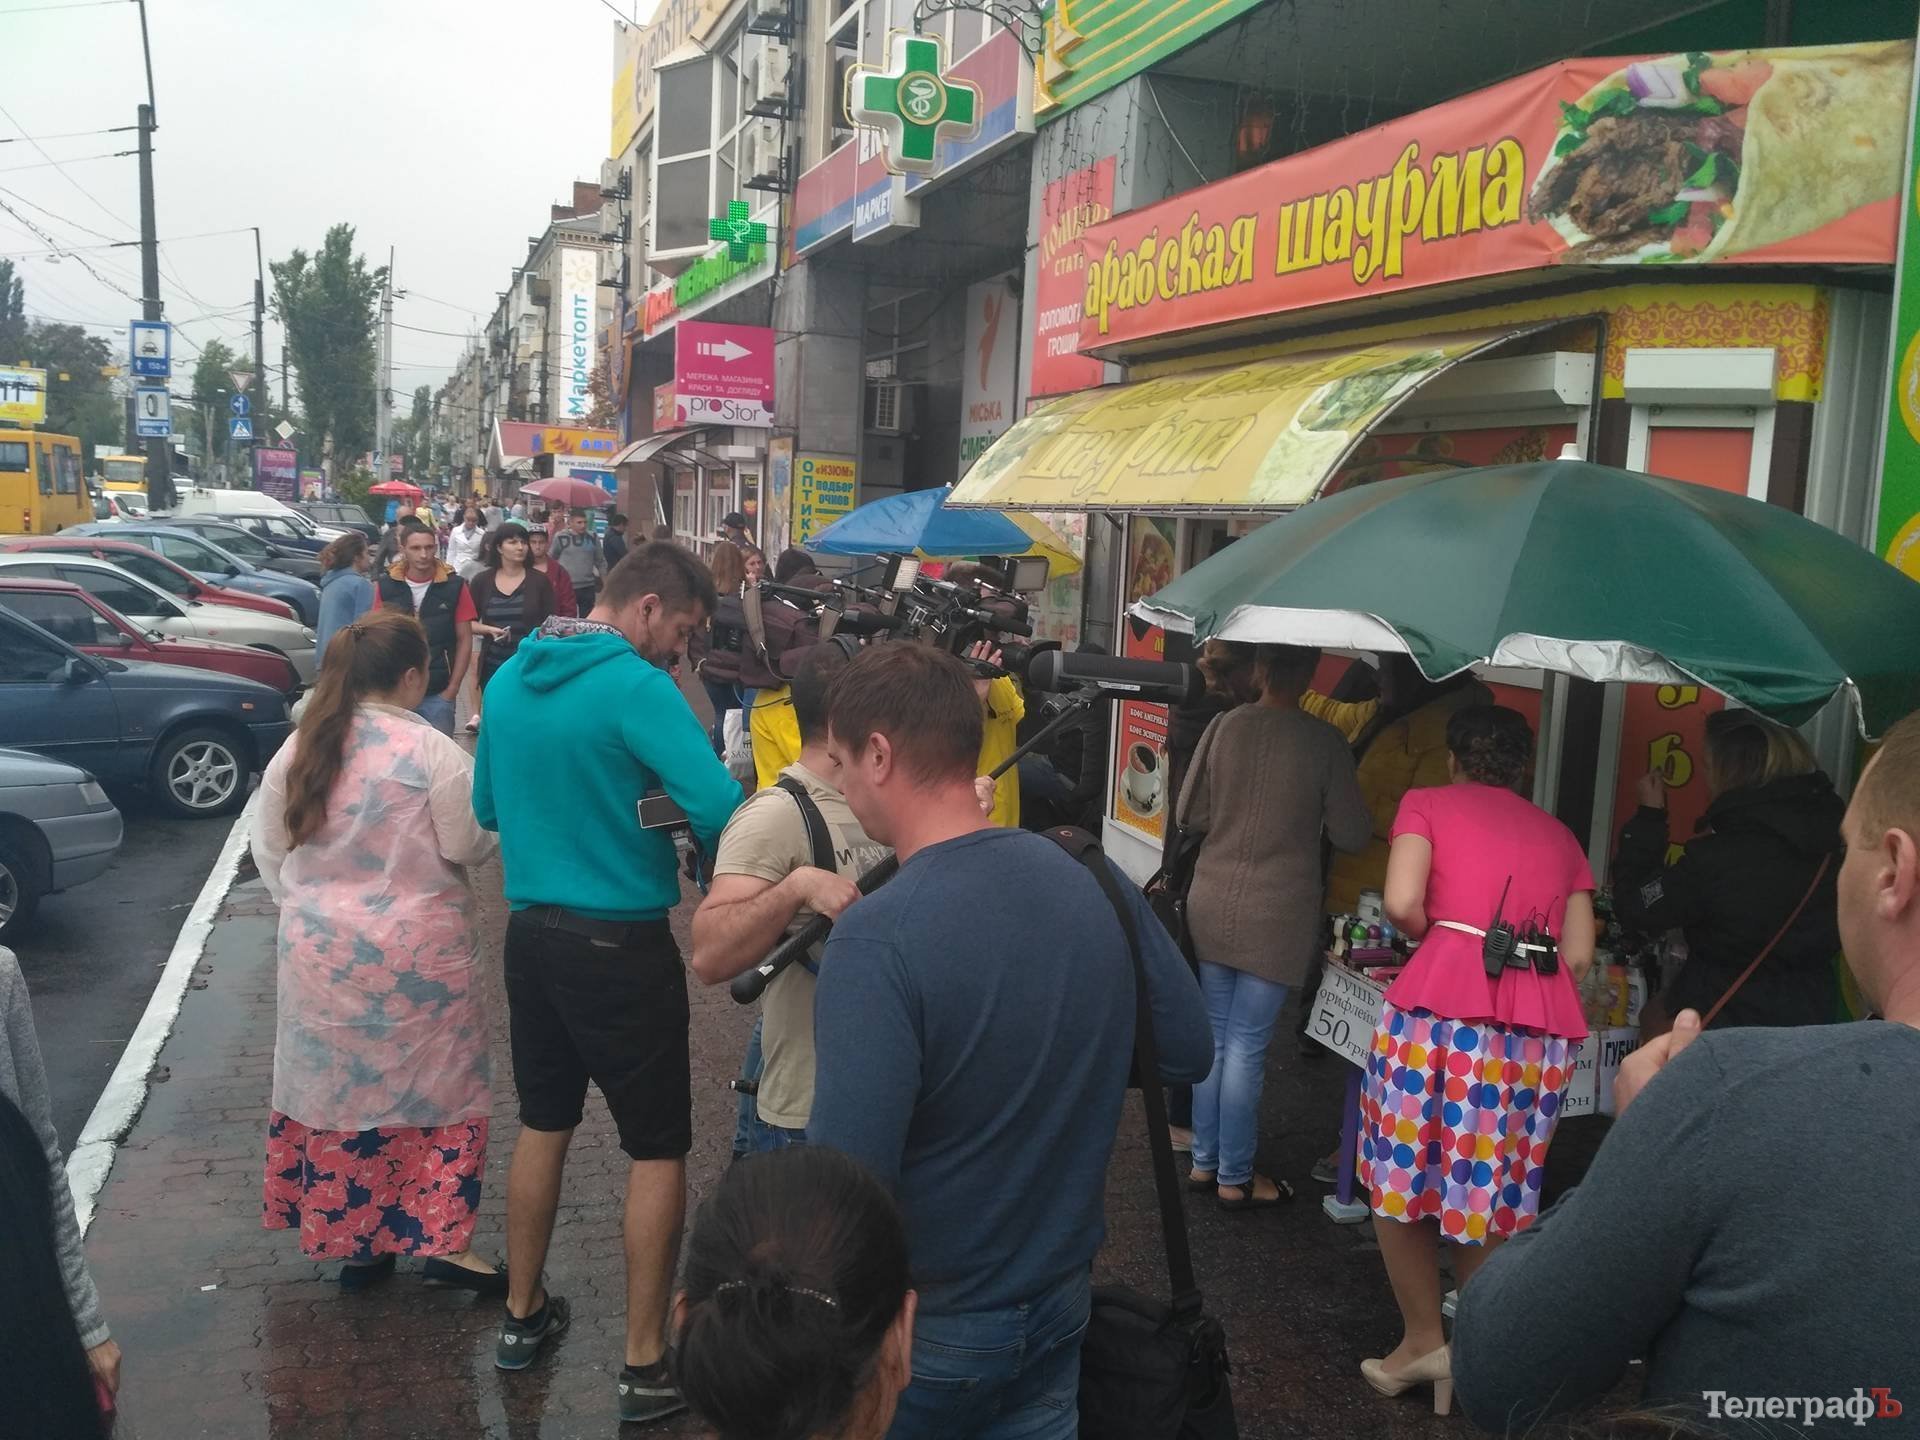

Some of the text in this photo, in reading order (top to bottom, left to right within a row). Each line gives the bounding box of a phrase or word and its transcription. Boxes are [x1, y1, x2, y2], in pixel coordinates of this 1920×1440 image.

[1085, 139, 1525, 335] арабская шаурма
[567, 293, 588, 415] Маркетопт
[690, 397, 761, 421] proStor
[1319, 988, 1377, 1027] орифлейм
